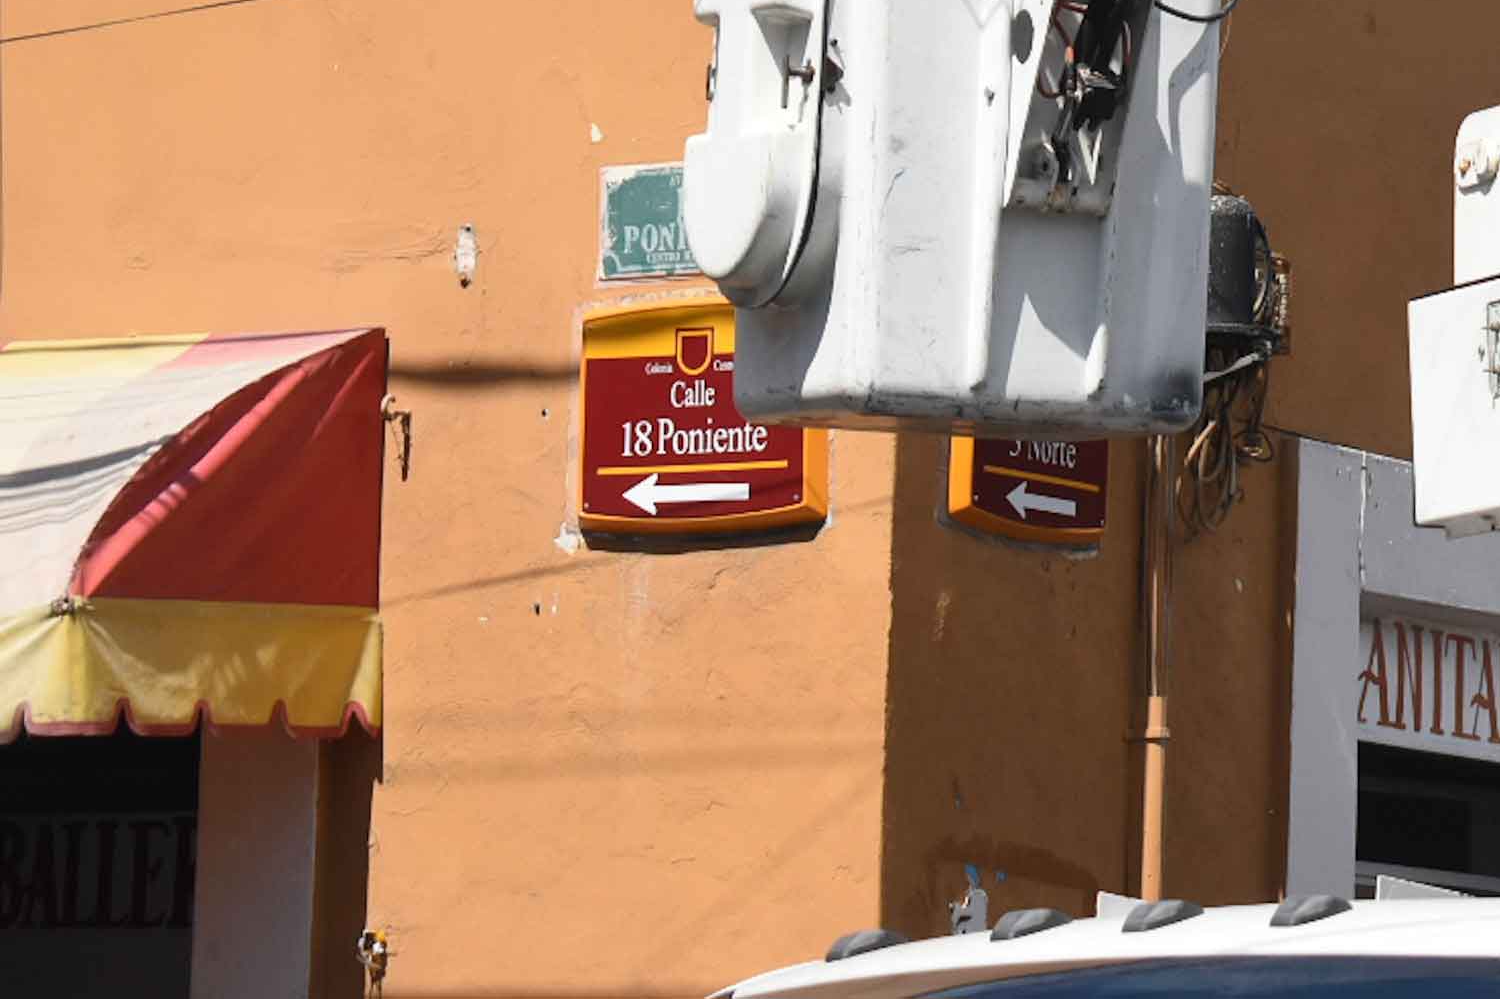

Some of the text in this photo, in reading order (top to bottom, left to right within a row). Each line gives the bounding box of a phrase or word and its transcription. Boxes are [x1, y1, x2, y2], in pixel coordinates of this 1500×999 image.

[670, 379, 716, 409] Calle
[621, 417, 768, 457] 18 Poniente
